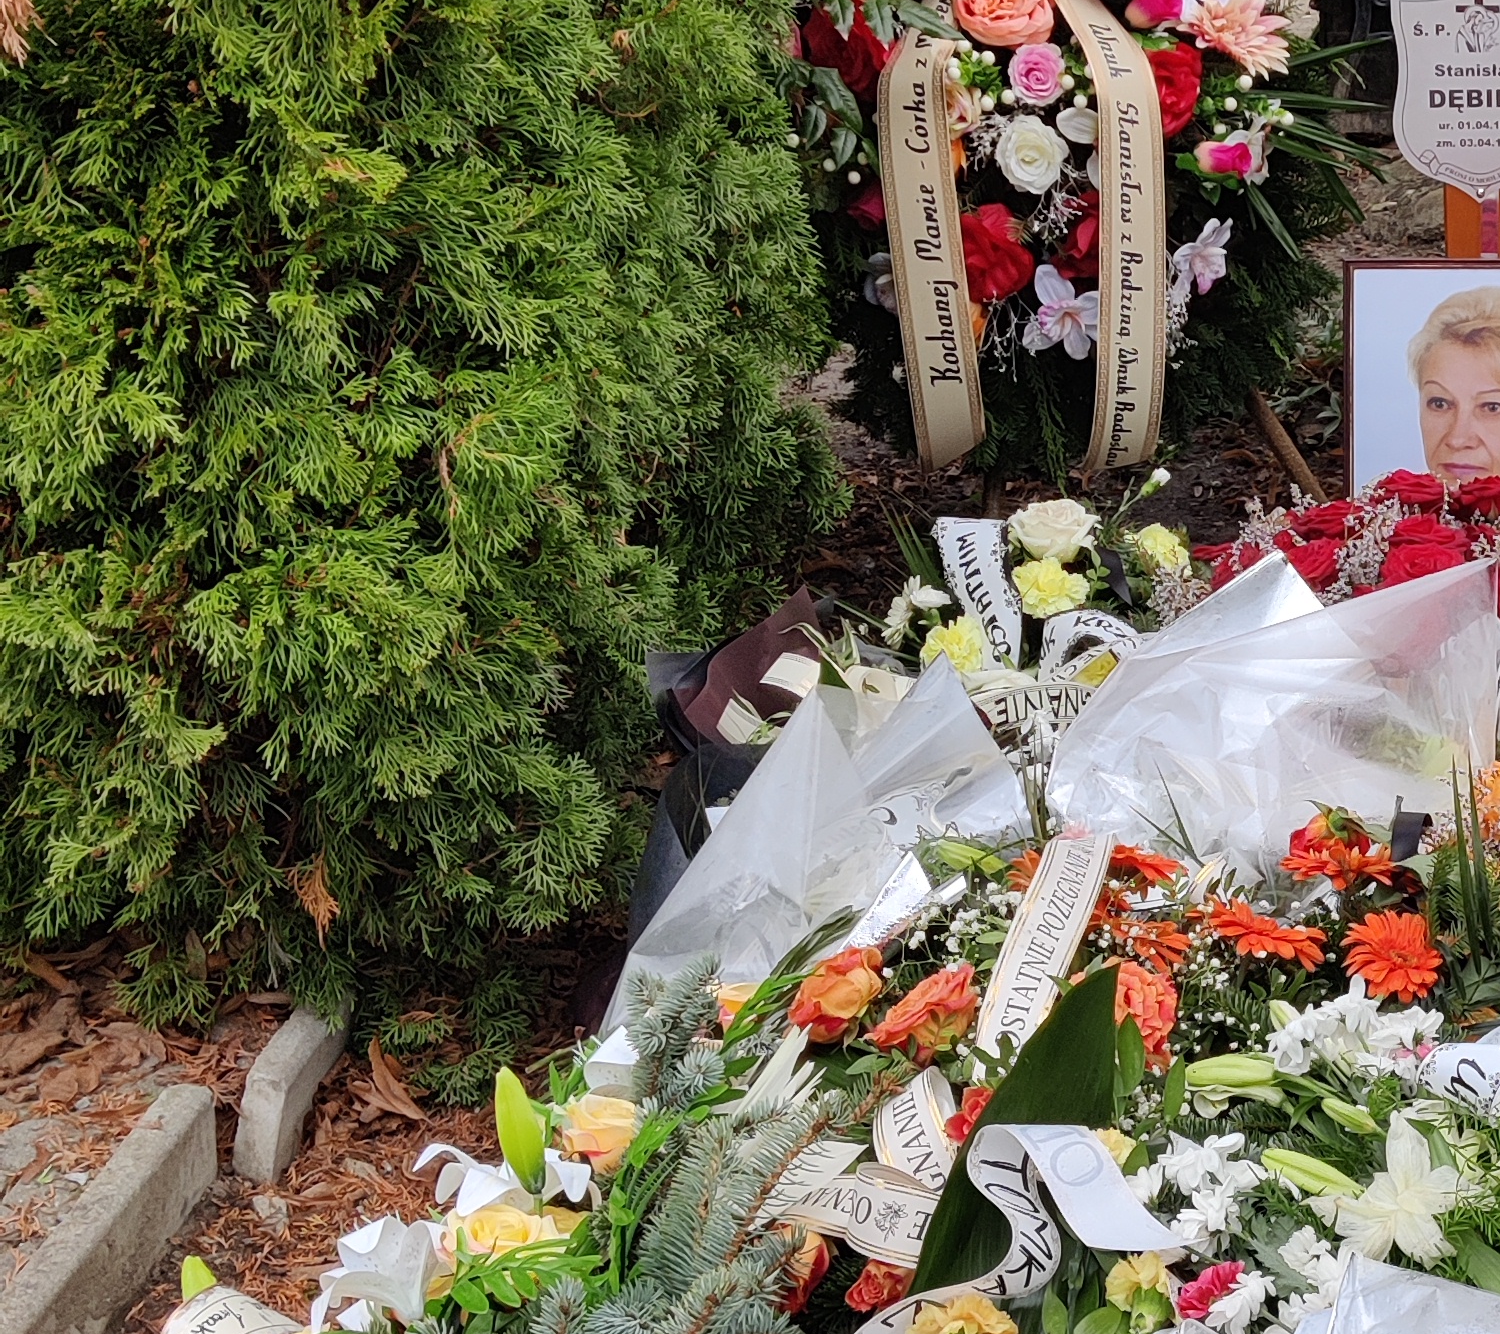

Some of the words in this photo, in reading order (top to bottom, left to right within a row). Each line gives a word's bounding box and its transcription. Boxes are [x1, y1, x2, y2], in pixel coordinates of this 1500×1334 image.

[1087, 22, 1133, 81] Wnuk
[1413, 21, 1429, 37] Ś.
[1435, 24, 1451, 36] P.
[915, 57, 928, 69] z
[904, 82, 931, 154] Córka
[1438, 122, 1454, 130] ur.
[1119, 231, 1133, 244] z
[928, 279, 963, 388] Kochanej
[1116, 347, 1139, 397] Wnuk
[1035, 849, 1092, 942] POŻEGNANIE
[973, 1152, 1053, 1299] TOMKA
